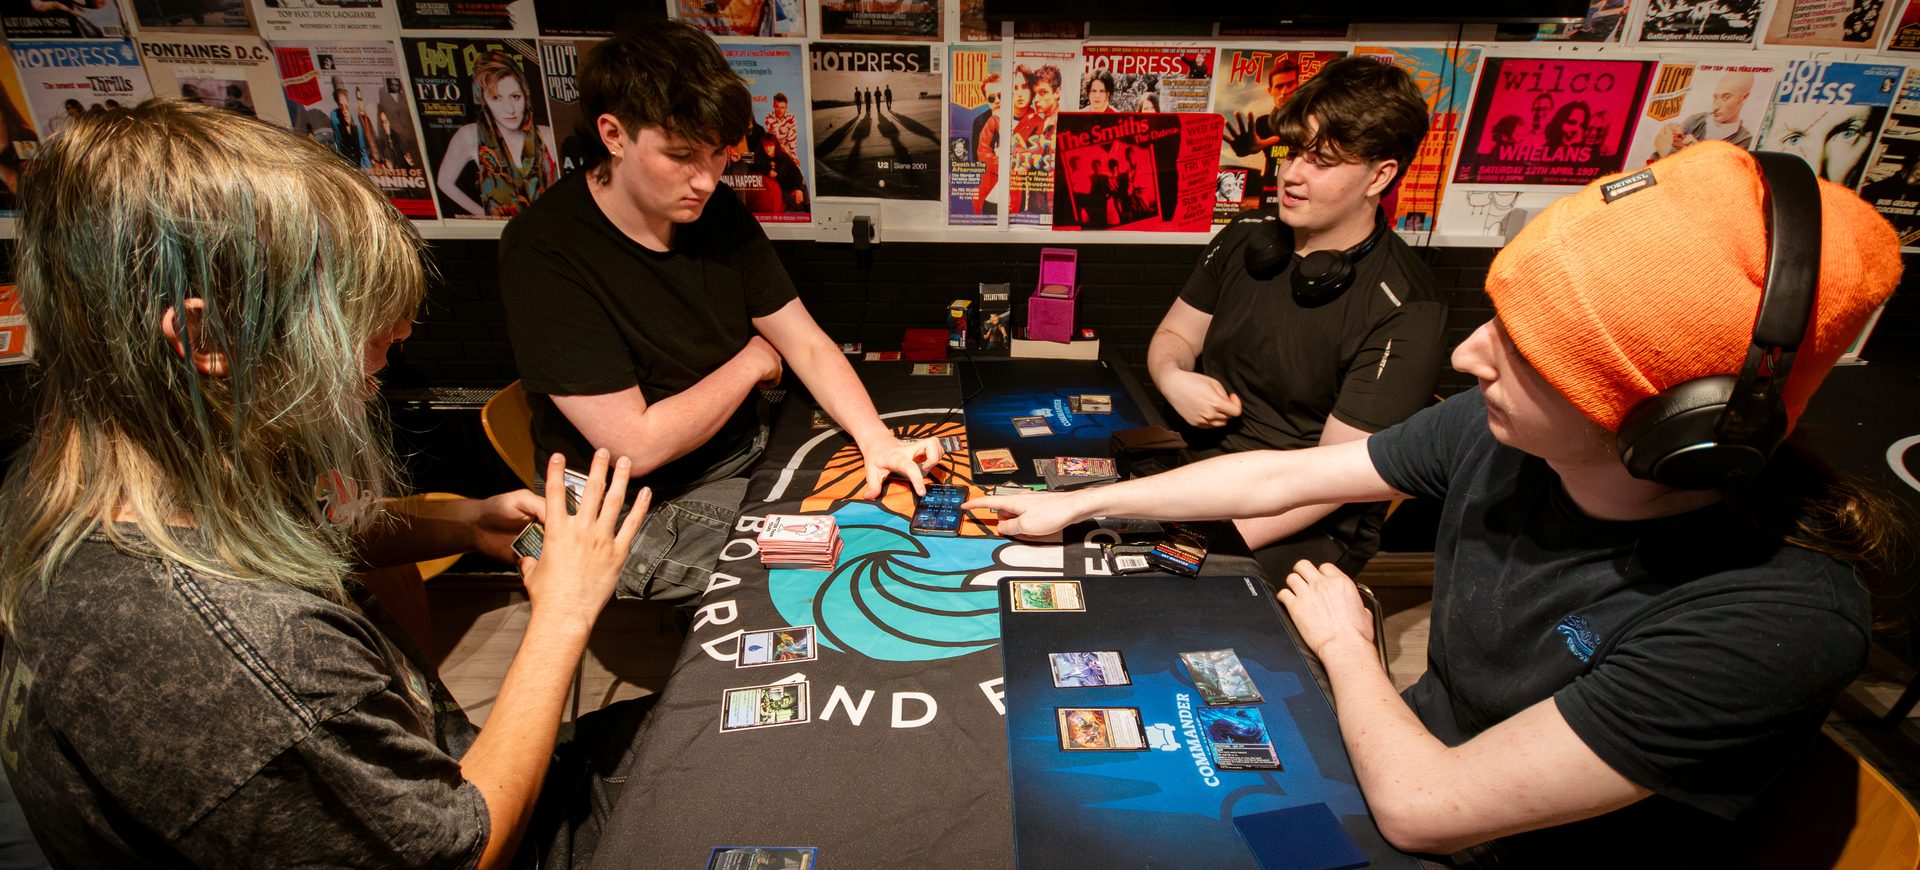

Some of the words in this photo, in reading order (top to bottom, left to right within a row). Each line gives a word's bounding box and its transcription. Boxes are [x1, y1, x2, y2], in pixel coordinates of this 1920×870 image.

[333, 11, 377, 19] LAOGHAIRE
[1816, 15, 1835, 23] sonny
[141, 43, 232, 59] FONTAINES
[235, 45, 269, 60] D.C.
[417, 41, 459, 77] HOT
[543, 45, 577, 76] HOT
[955, 53, 987, 81] HOT
[1230, 51, 1272, 85] HOT
[1504, 62, 1615, 94] wilco
[1783, 60, 1833, 82] HOT
[85, 75, 134, 93] Thrills
[416, 83, 461, 100] FLO
[1657, 67, 1693, 94] HOT
[955, 84, 986, 107] PRES
[1777, 81, 1856, 105] PRESS
[1011, 133, 1056, 150] ASH
[1056, 130, 1090, 150] The
[1091, 116, 1149, 144] Smiths
[1500, 145, 1593, 162] WHELANS
[877, 162, 889, 170] U2
[893, 162, 911, 171] Slane
[912, 162, 928, 170] 2001
[1479, 165, 1523, 174] SATURDAY
[1549, 167, 1575, 176] APRIL
[1576, 167, 1600, 176] 1997
[735, 175, 764, 188] HAPPEN!
[693, 514, 766, 663] BOARD
[1176, 692, 1221, 789] COMMANDER
